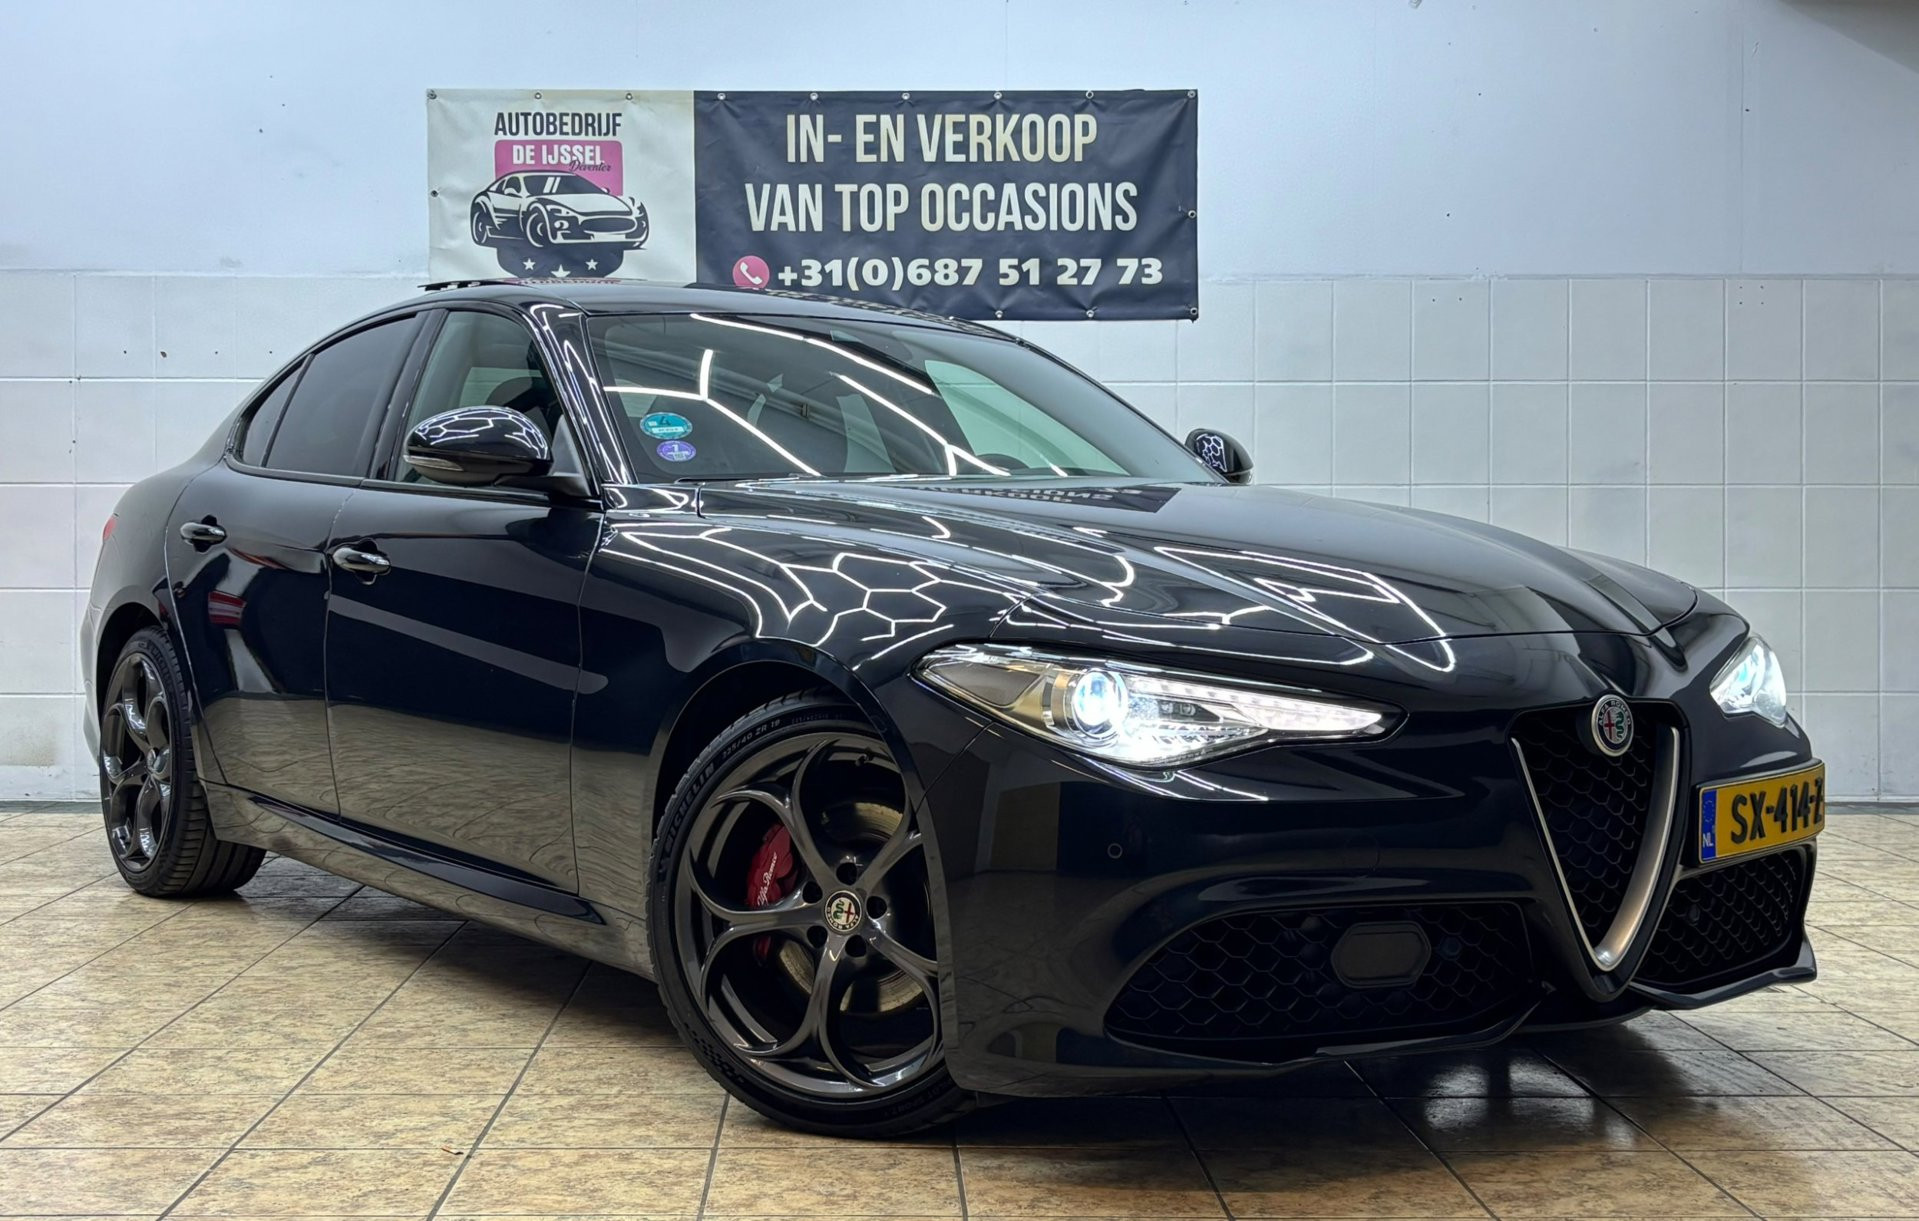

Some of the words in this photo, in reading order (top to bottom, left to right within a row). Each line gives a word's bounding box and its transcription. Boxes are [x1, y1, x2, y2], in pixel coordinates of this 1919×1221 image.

[494, 112, 622, 137] AUTOBEDRIJF
[786, 113, 842, 163] IN-
[856, 113, 904, 163] EN
[916, 113, 1098, 163] VERKOOP
[512, 144, 536, 165] DE
[541, 144, 605, 166] IJSSEL
[745, 182, 823, 232] VAN
[834, 182, 910, 232] TOP
[920, 181, 1138, 232] OCCASIONS
[778, 256, 983, 291] +31(0)687
[998, 257, 1040, 286] 51
[1056, 257, 1102, 286] 27
[1116, 256, 1163, 285] 73
[1702, 832, 1714, 849] NL
